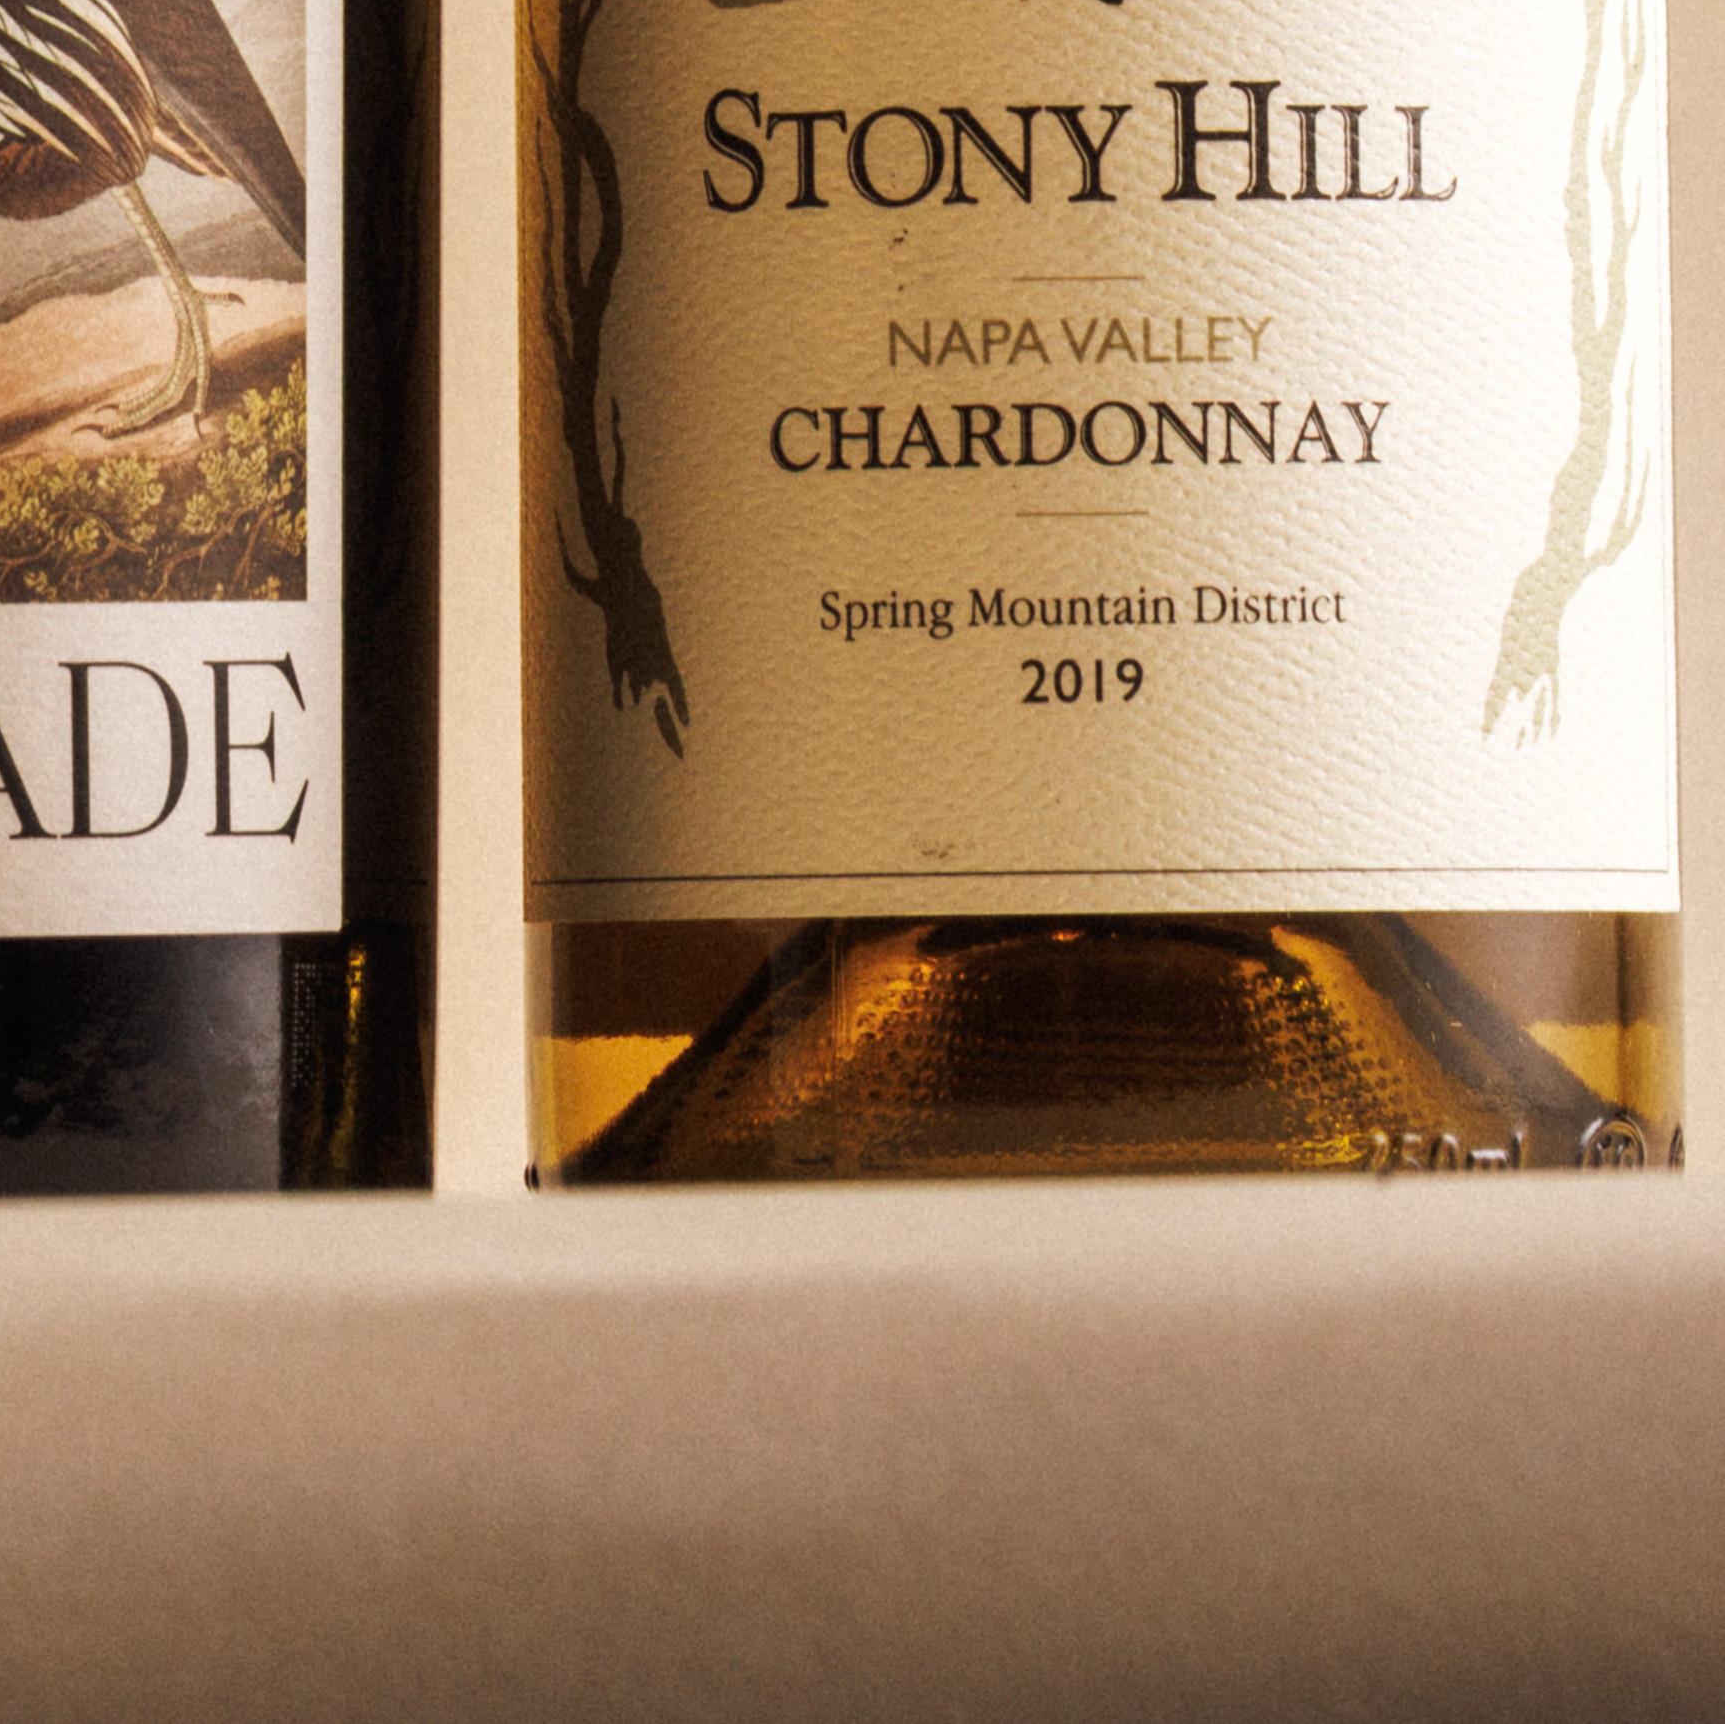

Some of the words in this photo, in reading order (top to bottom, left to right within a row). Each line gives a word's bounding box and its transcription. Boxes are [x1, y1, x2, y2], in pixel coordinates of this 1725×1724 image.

[703, 88, 1132, 214] STONY
[1154, 80, 1459, 202] HILL
[888, 318, 1051, 368] NAPA
[1060, 316, 1271, 364] VALLEY
[769, 400, 1391, 474] CHARDONNAY
[820, 590, 955, 643] Spring
[968, 586, 1176, 628] Mountain
[1194, 585, 1347, 625] District
[1021, 658, 1144, 704] 2019
